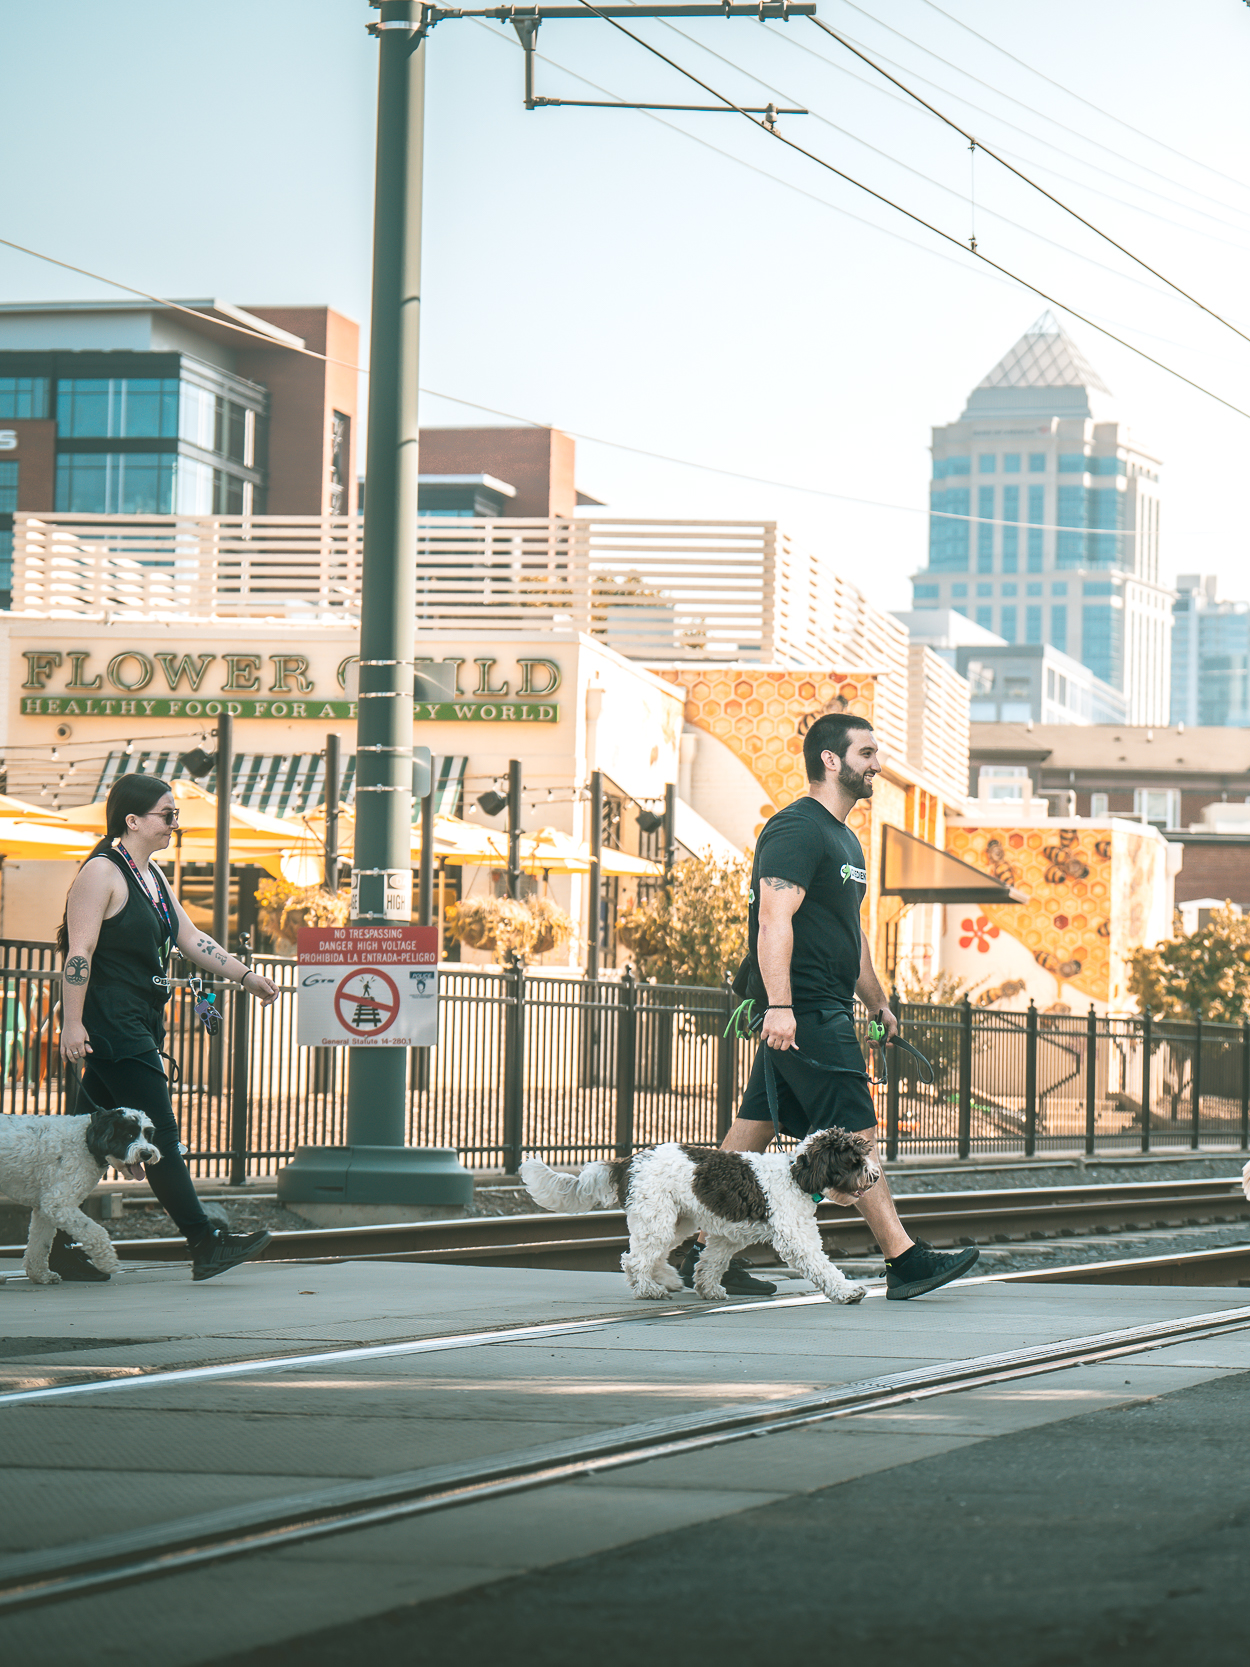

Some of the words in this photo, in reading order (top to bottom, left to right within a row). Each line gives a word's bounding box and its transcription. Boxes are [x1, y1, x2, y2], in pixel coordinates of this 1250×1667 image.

[21, 651, 314, 694] FLOWER
[24, 698, 156, 715] HEALTHY
[168, 700, 242, 716] FOOD
[254, 702, 307, 718] FOR
[318, 703, 336, 718] A
[453, 704, 555, 721] WORLD
[386, 894, 406, 910] HIGH
[334, 929, 346, 939] NO
[349, 928, 403, 939] TRESPASSING
[319, 940, 353, 951] DANGER
[357, 941, 378, 950] HIGH
[381, 940, 417, 950] VOLTAGE
[300, 952, 345, 962] PROHIBIDA
[347, 952, 358, 962] LA
[361, 952, 436, 963] ENTRADA-PELIGRO
